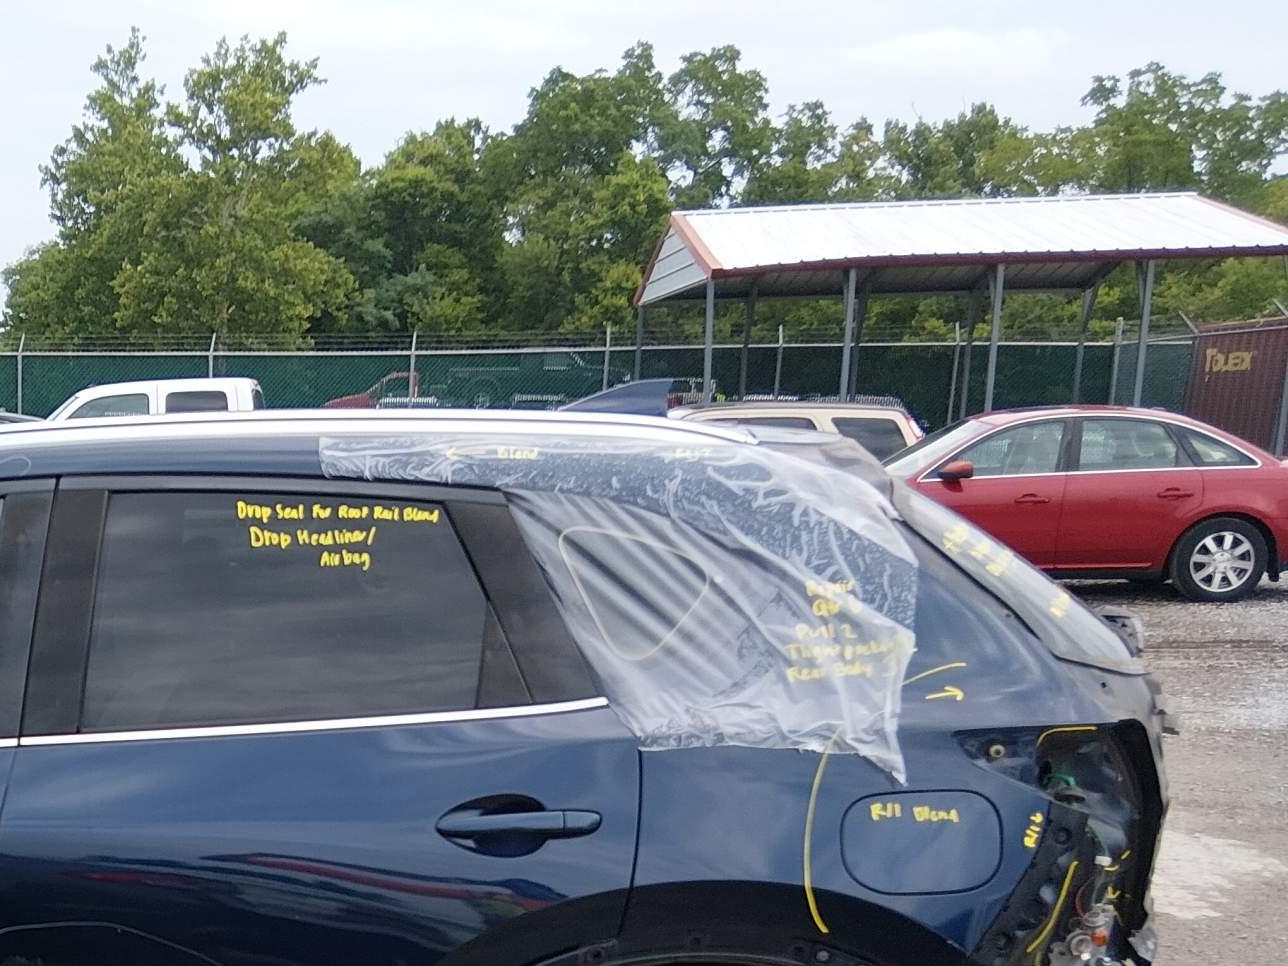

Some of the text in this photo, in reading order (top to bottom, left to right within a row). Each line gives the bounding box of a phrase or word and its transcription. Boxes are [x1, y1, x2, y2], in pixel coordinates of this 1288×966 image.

[237, 501, 271, 523] Drop
[275, 504, 304, 520] Seal
[373, 506, 400, 521] Rail
[403, 507, 440, 523] Blend
[249, 526, 291, 549] Drop
